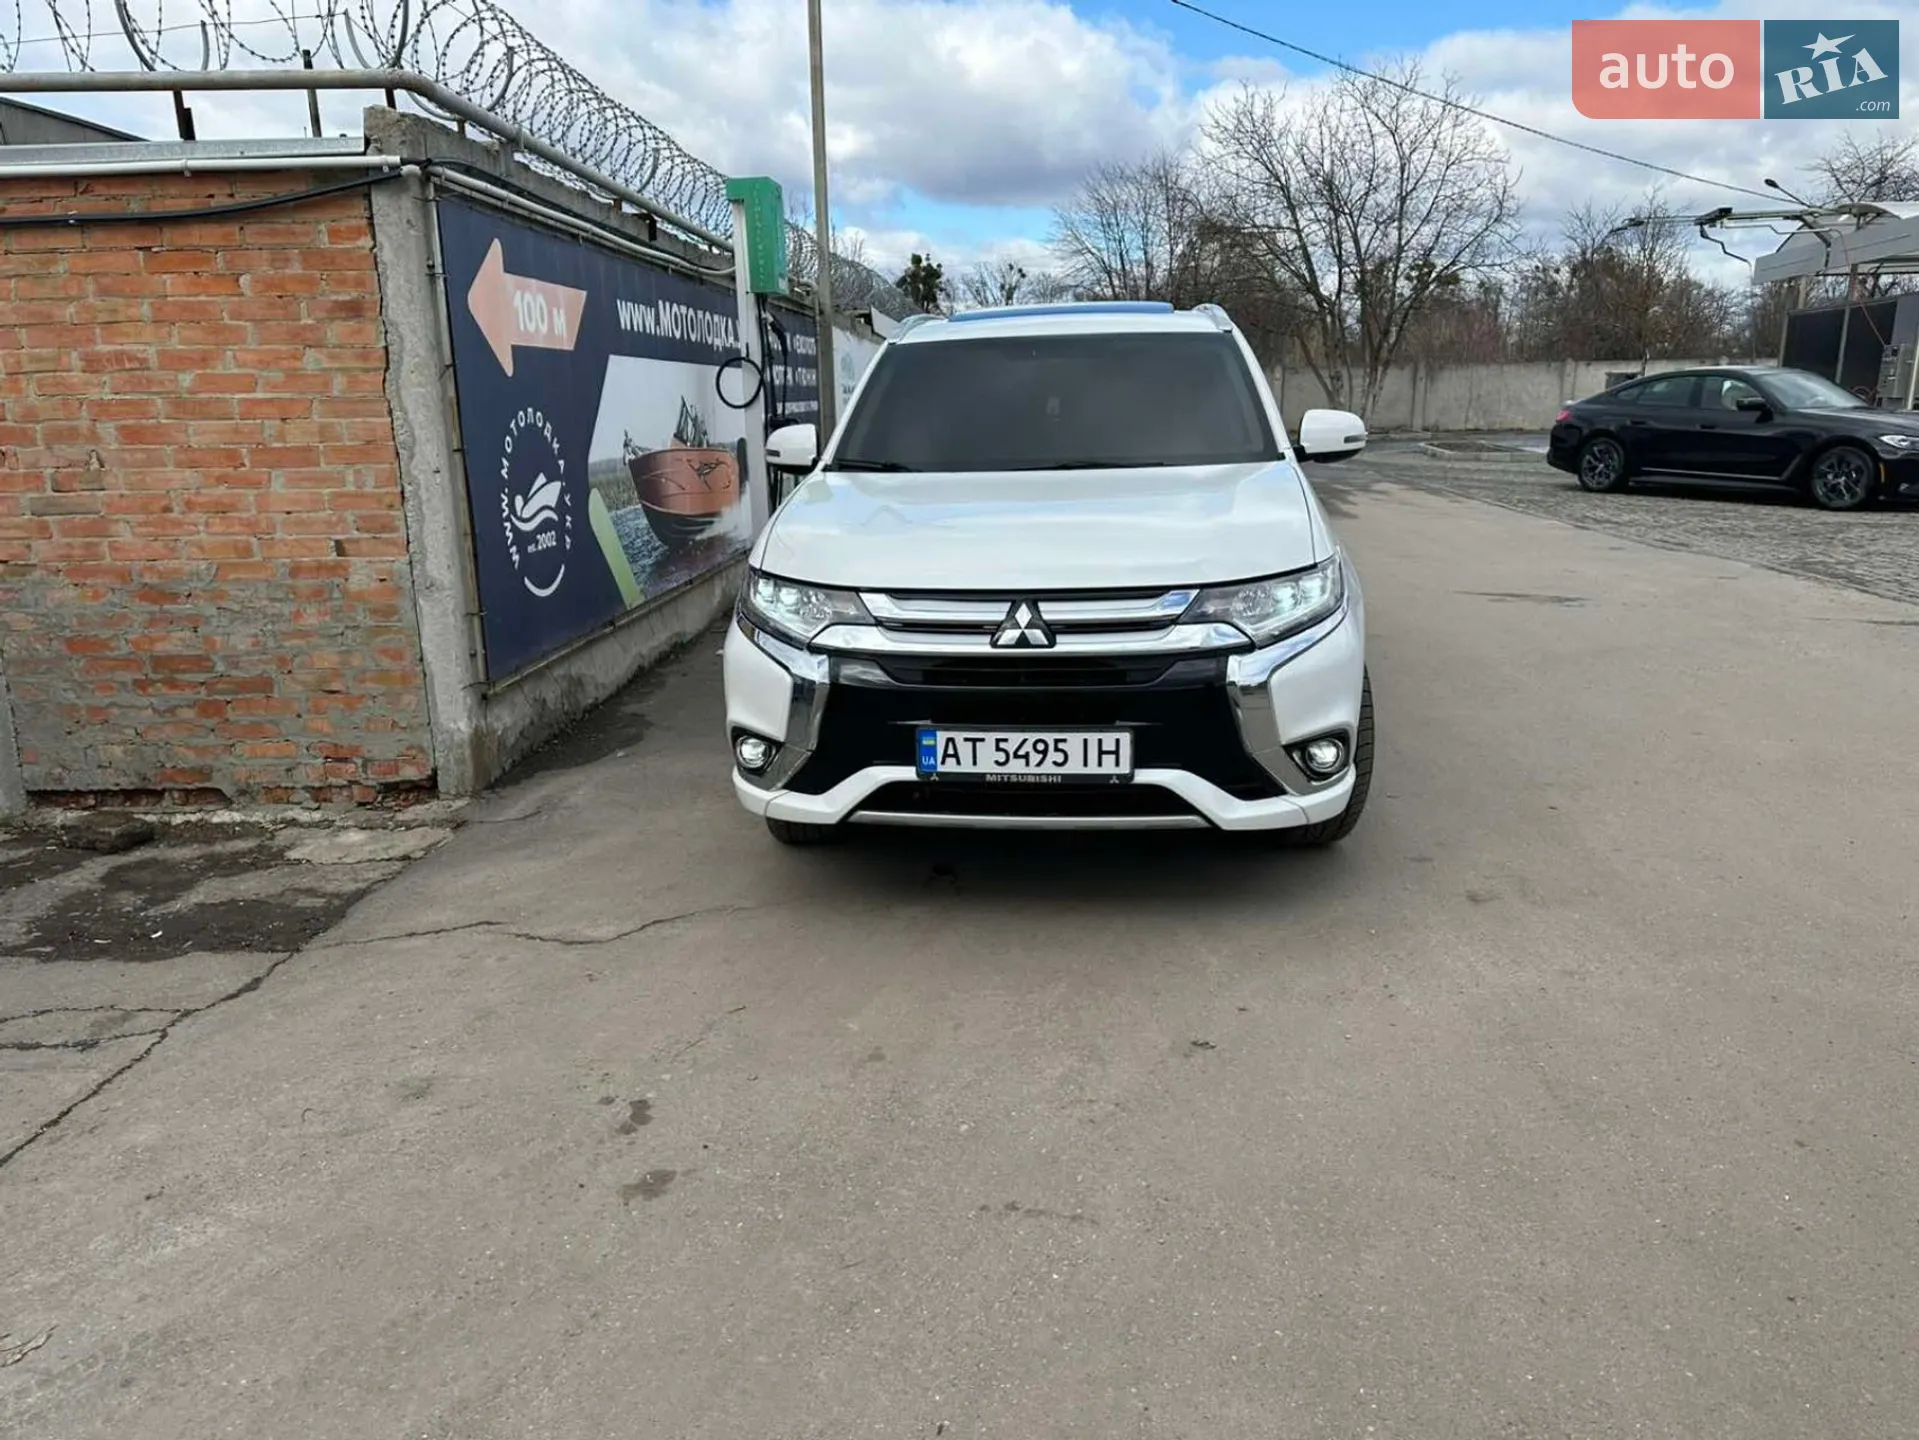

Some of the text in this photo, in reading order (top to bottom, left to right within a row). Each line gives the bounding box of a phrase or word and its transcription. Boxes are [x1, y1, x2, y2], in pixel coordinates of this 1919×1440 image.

[513, 290, 548, 335] 100
[922, 756, 936, 765] UA
[940, 737, 1121, 767] AT 5495 IH
[985, 774, 1062, 783] MITSUBISHI
